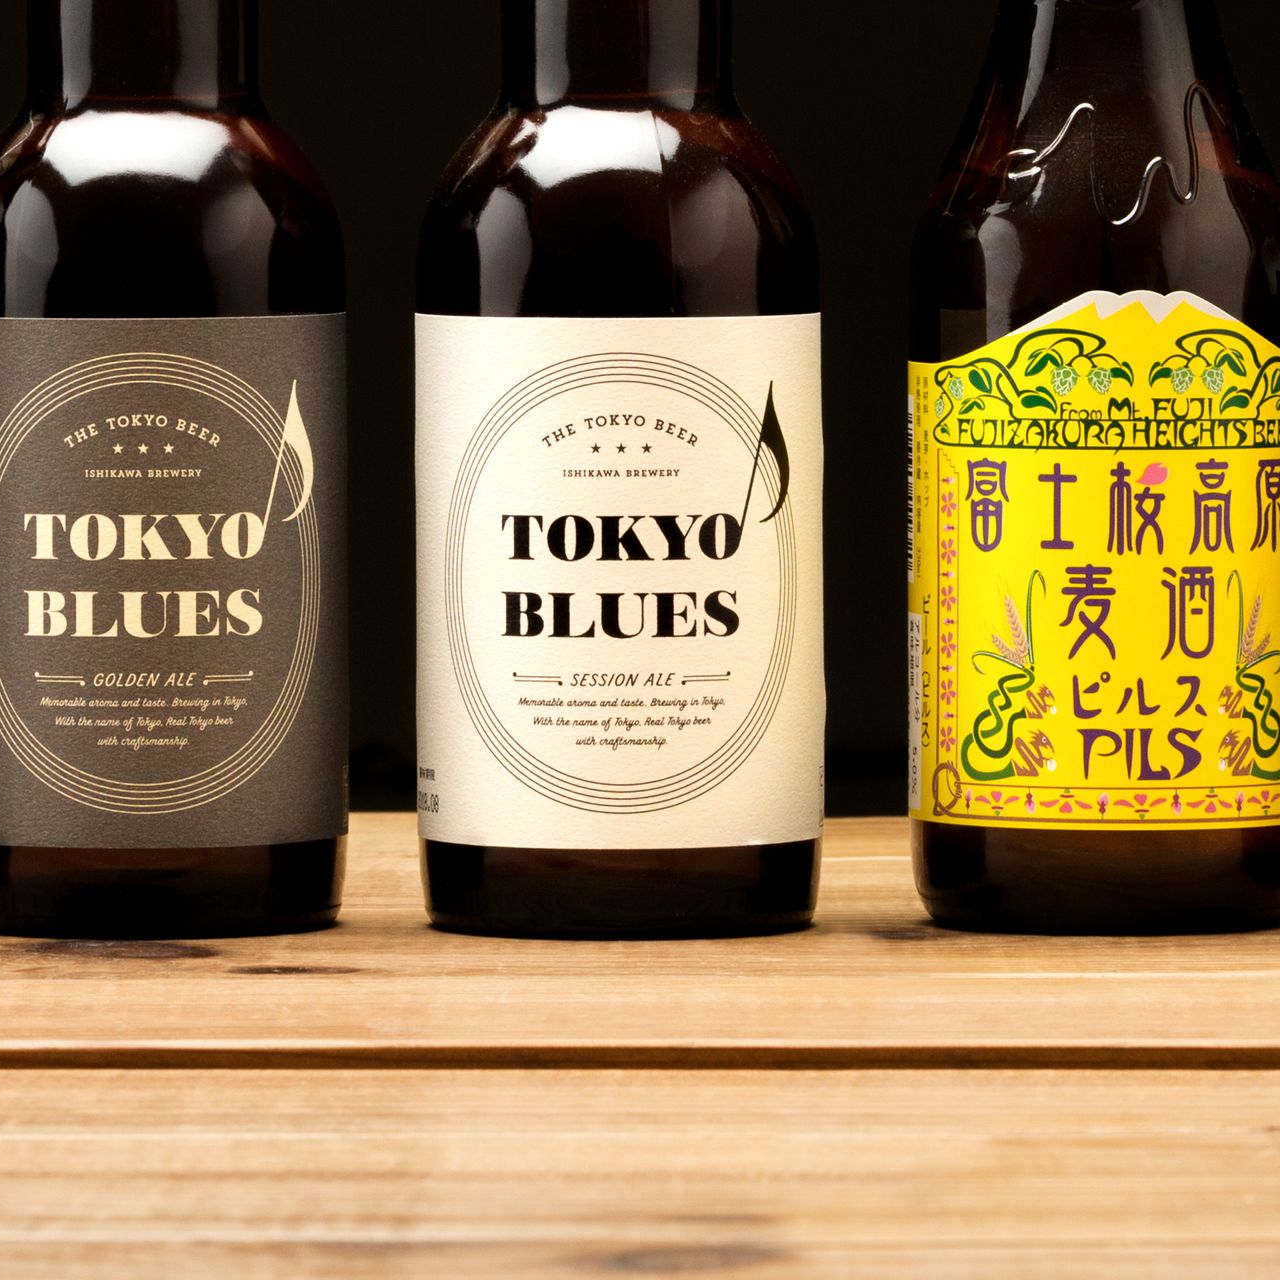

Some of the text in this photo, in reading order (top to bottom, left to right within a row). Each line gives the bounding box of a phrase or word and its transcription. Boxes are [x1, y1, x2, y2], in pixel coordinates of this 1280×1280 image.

[1108, 397, 1150, 420] Mt.
[1152, 398, 1213, 420] FUJI
[63, 414, 221, 449] THE TOKYO BEER
[541, 414, 699, 448] THE TOKYO BEER
[957, 419, 1125, 453] FUJIZAKURA
[1132, 419, 1247, 447] HEIGHTS
[84, 468, 203, 478] ISHIKAWA BREWERY
[562, 468, 680, 478] ISHIKAWA BREWERY
[23, 511, 266, 561] TOKYO
[501, 511, 743, 562] TOKYO
[23, 588, 263, 638] BLUES
[501, 589, 740, 639] BLUES
[1059, 563, 1216, 661] 麦酒
[93, 672, 197, 687] GOLDEN ALE
[570, 672, 676, 687] SESSION ALE
[40, 696, 86, 707] Memorable
[88, 699, 118, 707] aroma
[121, 697, 140, 707] and
[172, 697, 210, 711] Brewing
[212, 697, 221, 706] in
[518, 697, 564, 707] Memorable
[567, 699, 597, 707] aroma
[600, 697, 619, 707] and
[650, 697, 688, 711] Brewing
[690, 697, 699, 706] in
[1072, 671, 1208, 719] ピルス
[55, 715, 76, 726] With
[78, 716, 92, 726] the
[123, 716, 134, 731] of
[166, 716, 187, 726] Real
[188, 716, 213, 731] Tokyo
[214, 716, 233, 725] beer
[533, 716, 554, 726] With
[556, 716, 571, 726] the
[572, 719, 599, 727] name
[601, 716, 613, 731] of
[644, 716, 665, 726] Real
[667, 716, 692, 730] Tokyo
[693, 716, 712, 725] beer
[97, 735, 190, 751] with craftsmanship.
[576, 735, 668, 750] with craftsmanship.
[1076, 727, 1205, 781] PILS
